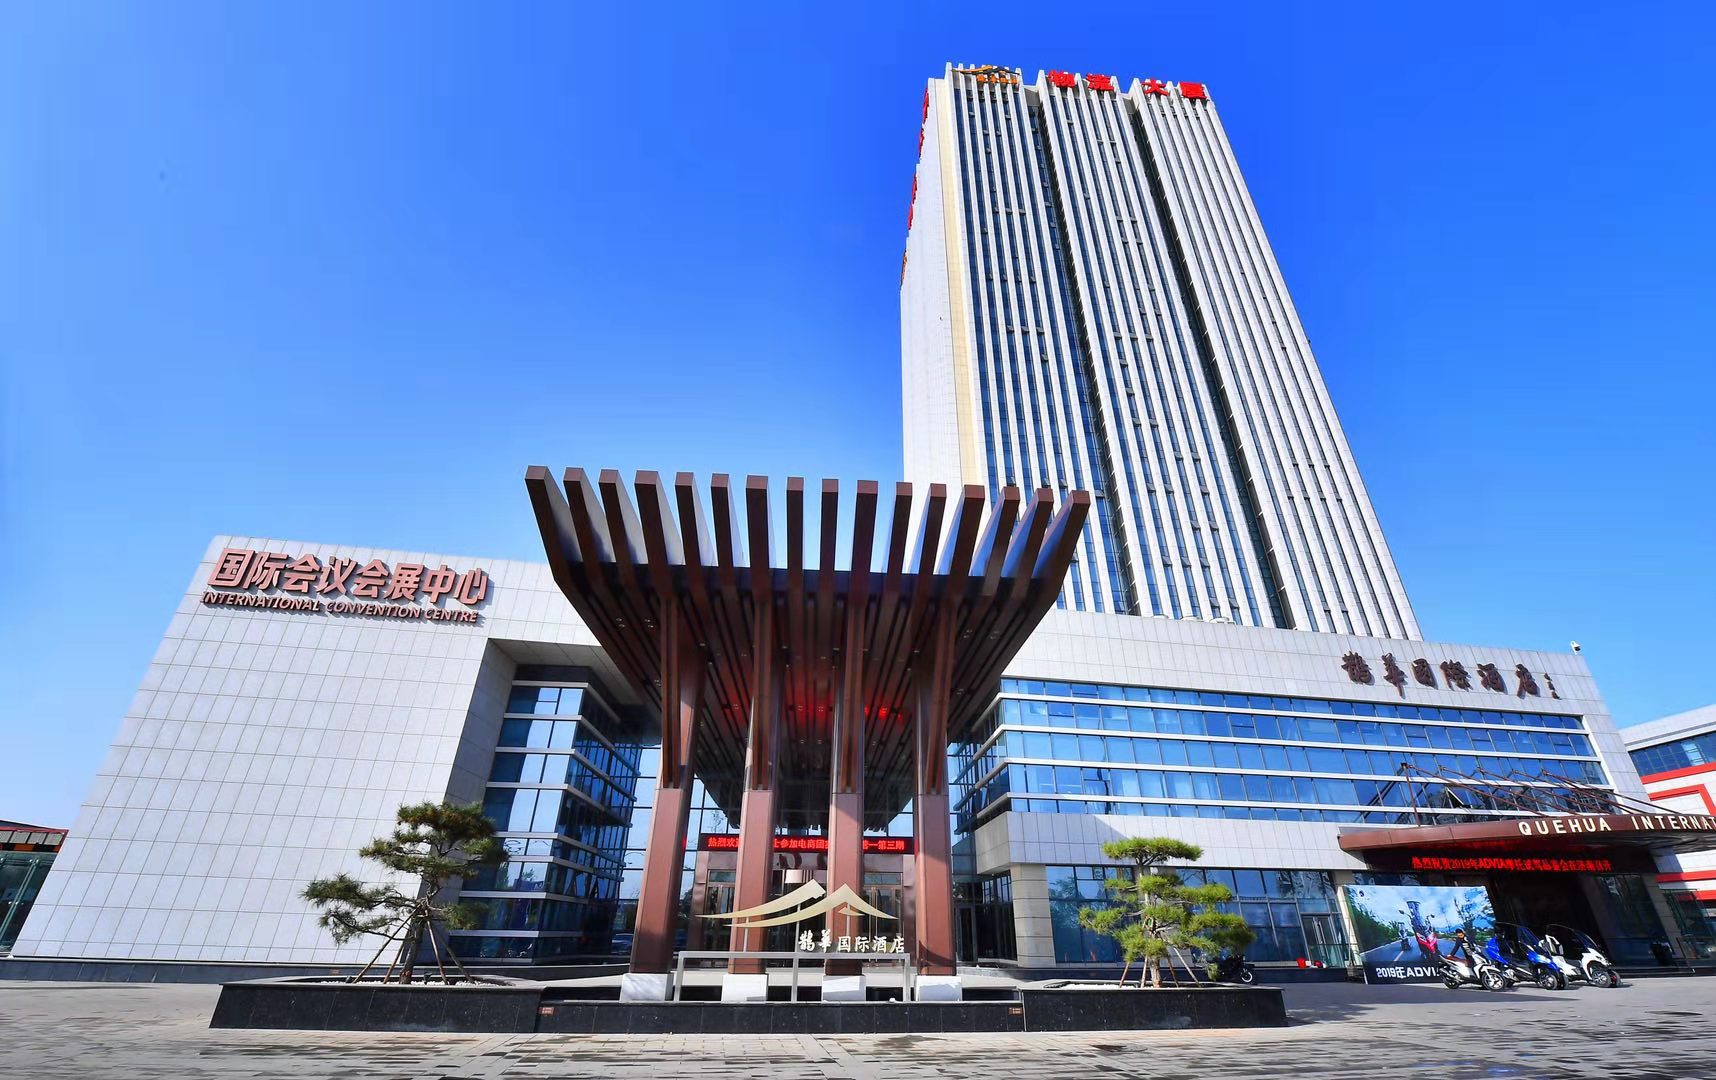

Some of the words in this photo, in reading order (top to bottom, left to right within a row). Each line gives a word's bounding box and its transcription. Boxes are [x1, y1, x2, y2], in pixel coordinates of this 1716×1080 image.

[207, 548, 489, 605] 国际会议会展中心
[202, 590, 321, 612] INTERNATIONAL
[325, 600, 421, 619] CONVENTION
[423, 608, 478, 624] CENTRE
[1518, 817, 1612, 836] QUEHUA
